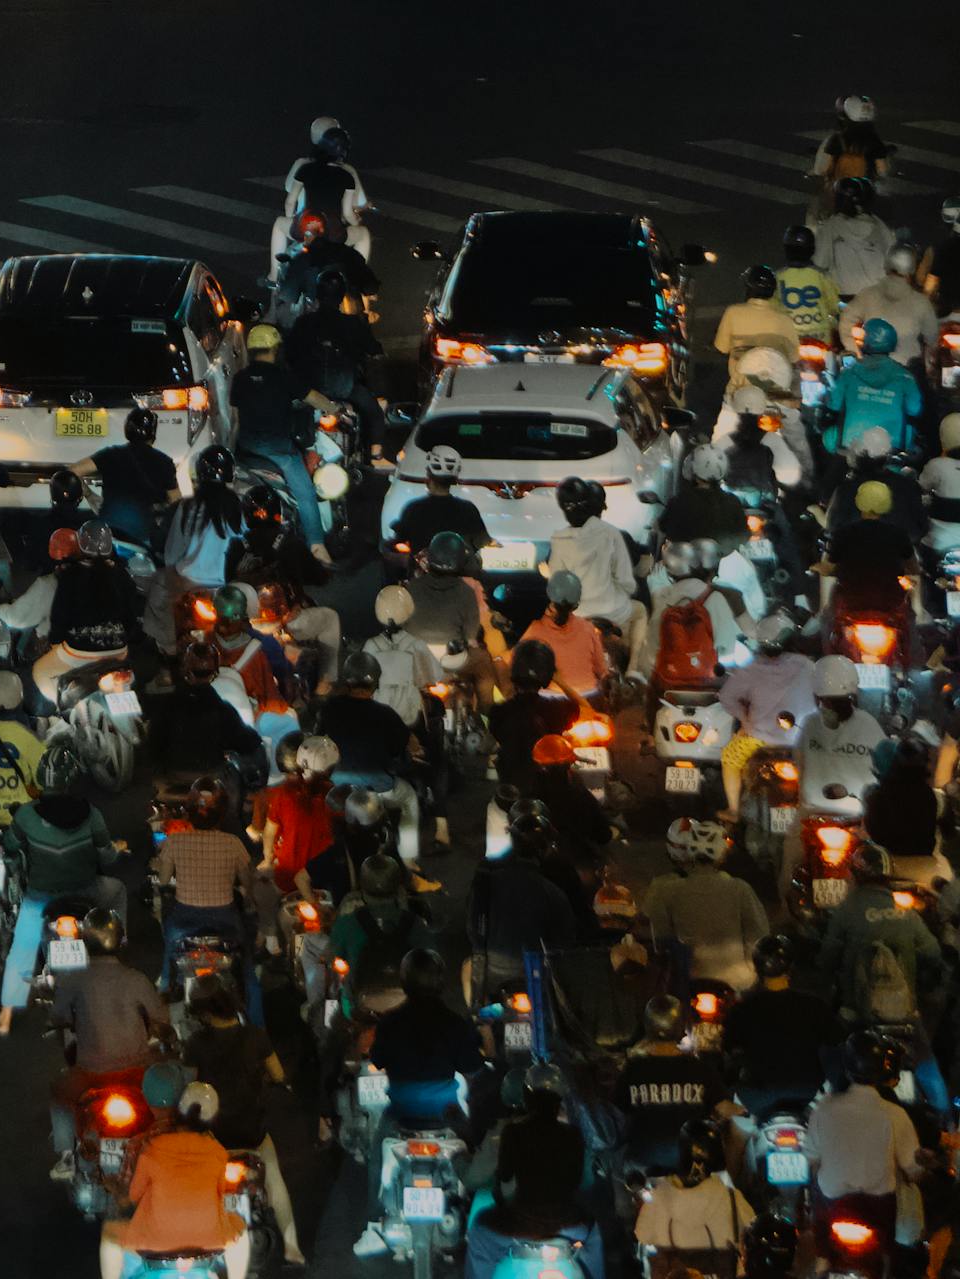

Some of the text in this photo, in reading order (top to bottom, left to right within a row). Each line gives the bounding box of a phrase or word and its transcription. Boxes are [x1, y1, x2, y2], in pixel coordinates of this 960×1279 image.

[781, 280, 822, 309] be
[72, 412, 92, 423] 50H
[629, 1082, 704, 1105] PARADOX
